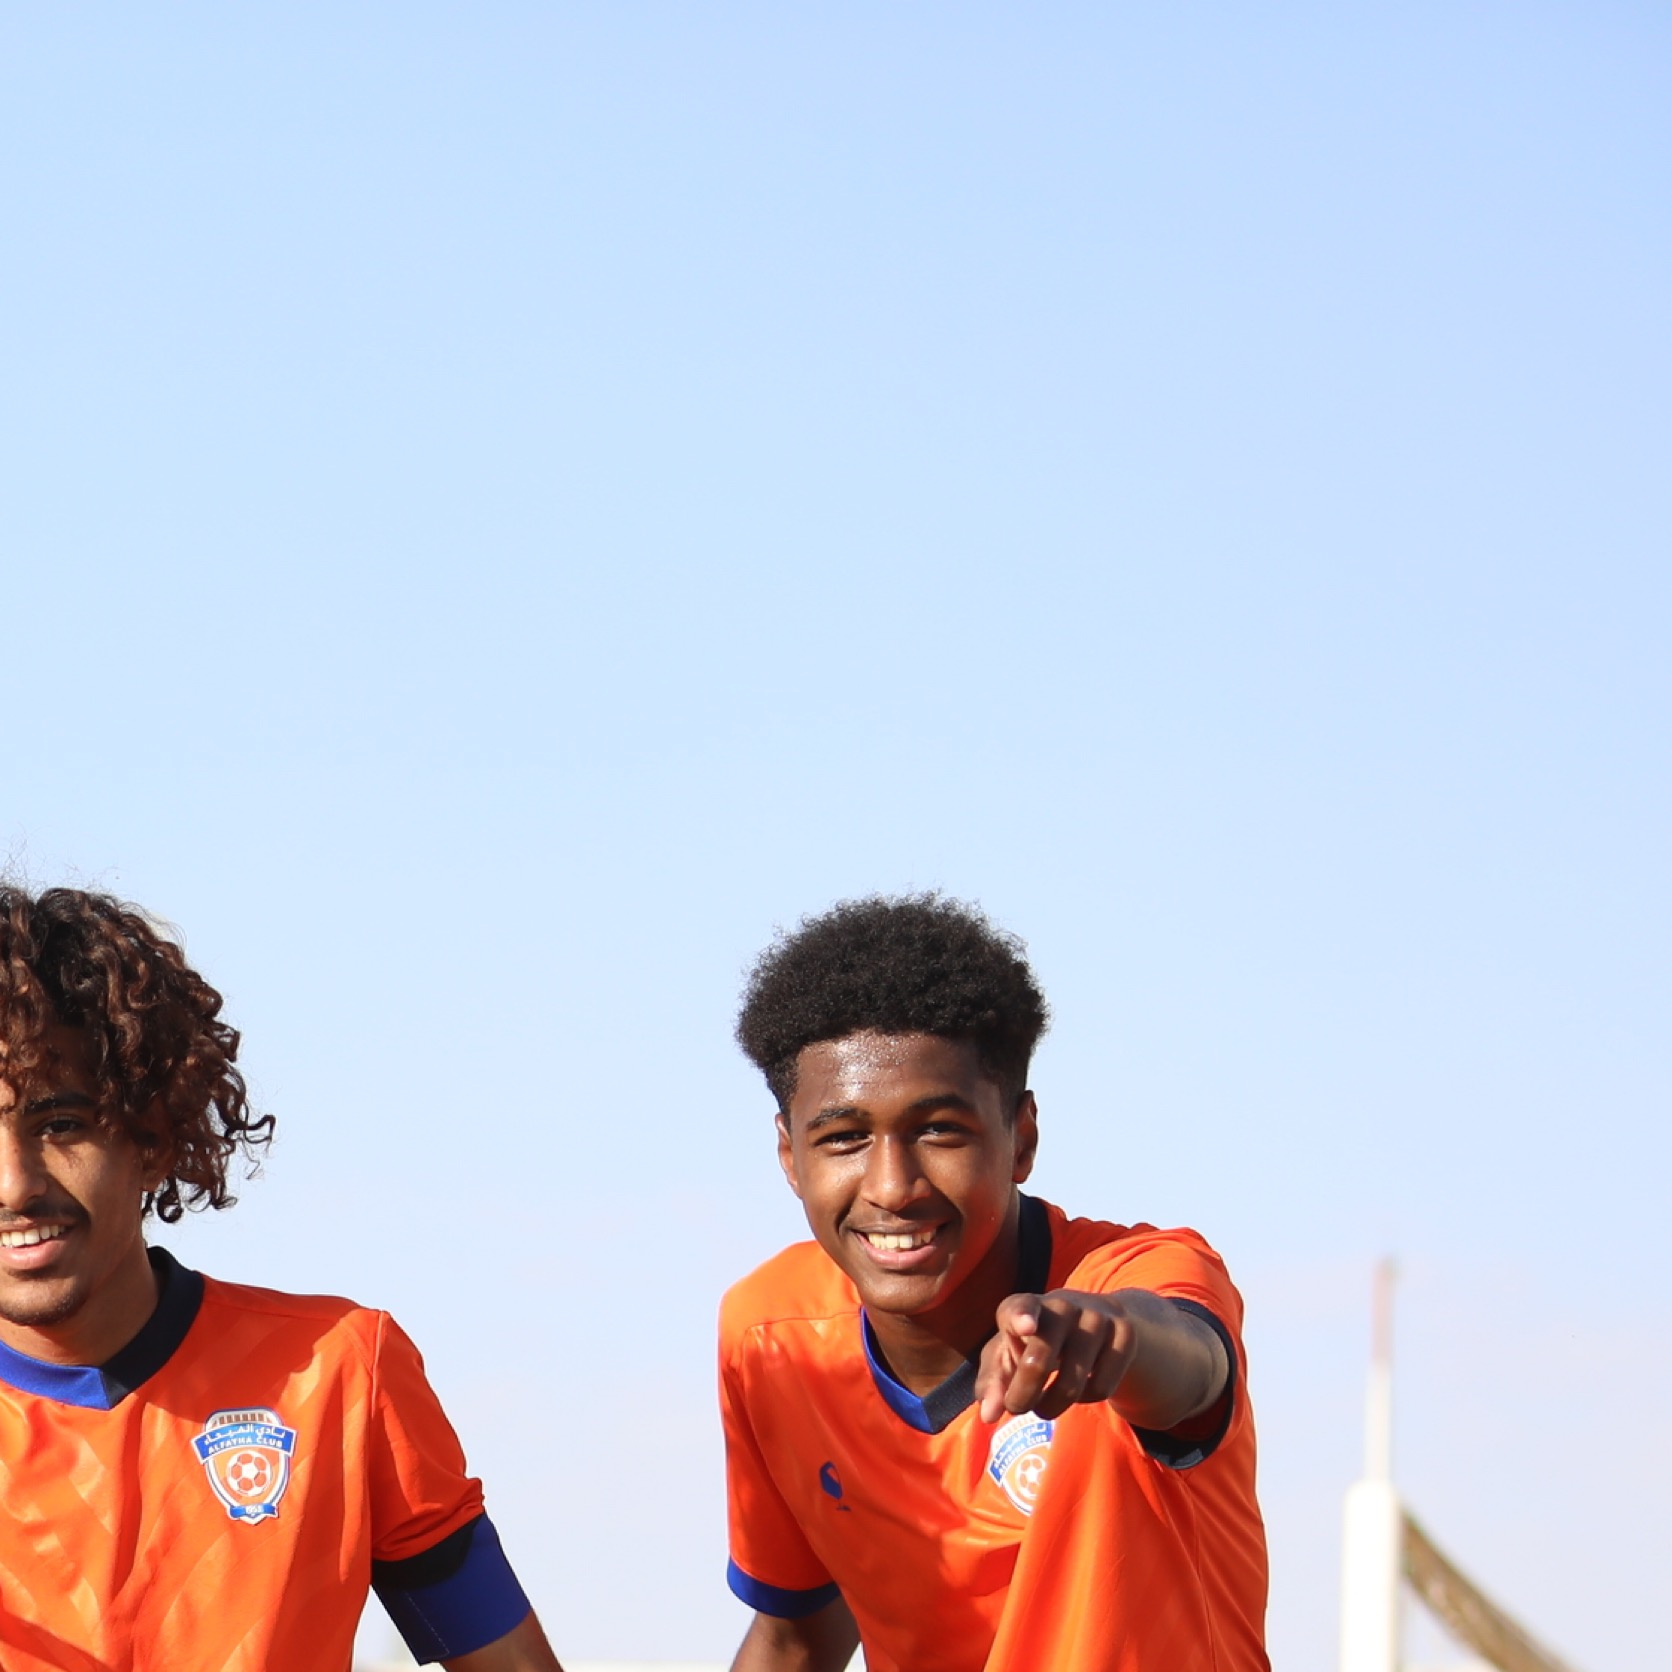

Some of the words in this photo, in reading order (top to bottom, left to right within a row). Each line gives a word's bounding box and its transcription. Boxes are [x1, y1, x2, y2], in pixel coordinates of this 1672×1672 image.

[205, 1424, 254, 1445] الفيحاء
[256, 1425, 285, 1438] نادي
[209, 1438, 253, 1454] ALFAYHA
[256, 1438, 282, 1447] CLUB
